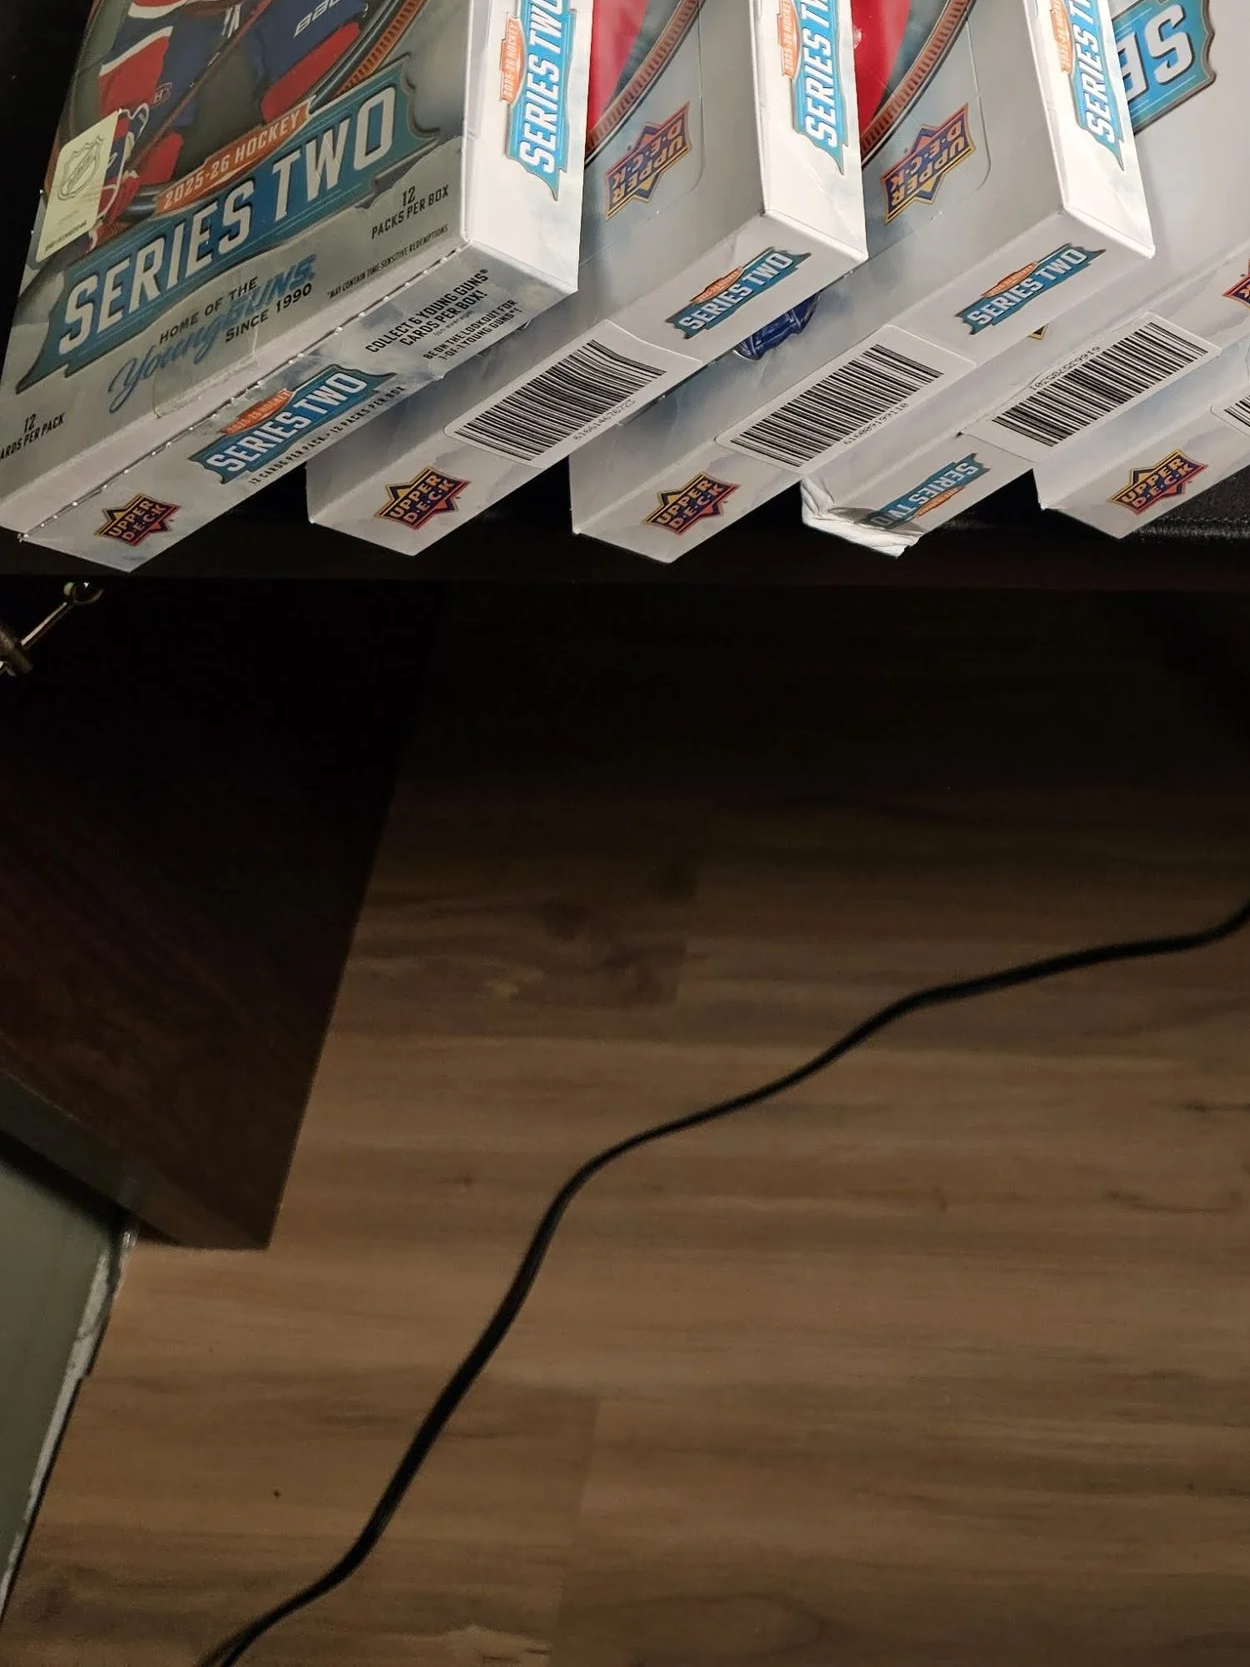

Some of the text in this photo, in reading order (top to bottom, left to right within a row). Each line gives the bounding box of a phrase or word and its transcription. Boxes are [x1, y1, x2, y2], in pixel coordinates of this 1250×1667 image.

[519, 54, 561, 174] SERIES
[803, 26, 838, 148] SERIES
[1074, 24, 1115, 144] SERIES
[163, 110, 301, 208] 2025-26 HOCKEY
[614, 135, 684, 203] UPPER
[892, 135, 967, 205] UPPER
[58, 86, 397, 356] SERIES TWO
[371, 185, 450, 240] PACKS PER BOX
[401, 186, 416, 207] 12
[159, 276, 259, 347] HOME OF THE
[225, 283, 313, 344] SINCE 1990
[399, 321, 440, 346] CARDS
[435, 305, 460, 327] PER
[456, 289, 488, 312] BOX!
[678, 251, 793, 330] SERIES TWO
[967, 248, 1087, 325] SERIES TWO
[0, 411, 65, 461] ARDS PER PACK
[24, 413, 37, 433] 12
[207, 412, 313, 473] SERIES
[296, 372, 369, 417] TWO
[259, 458, 288, 479] CARDS
[389, 473, 442, 521] UPPER
[658, 478, 712, 525] UPPER
[871, 461, 978, 528] SERIES TWO
[1121, 455, 1188, 503] UPPER
[110, 498, 153, 537] UPPER
